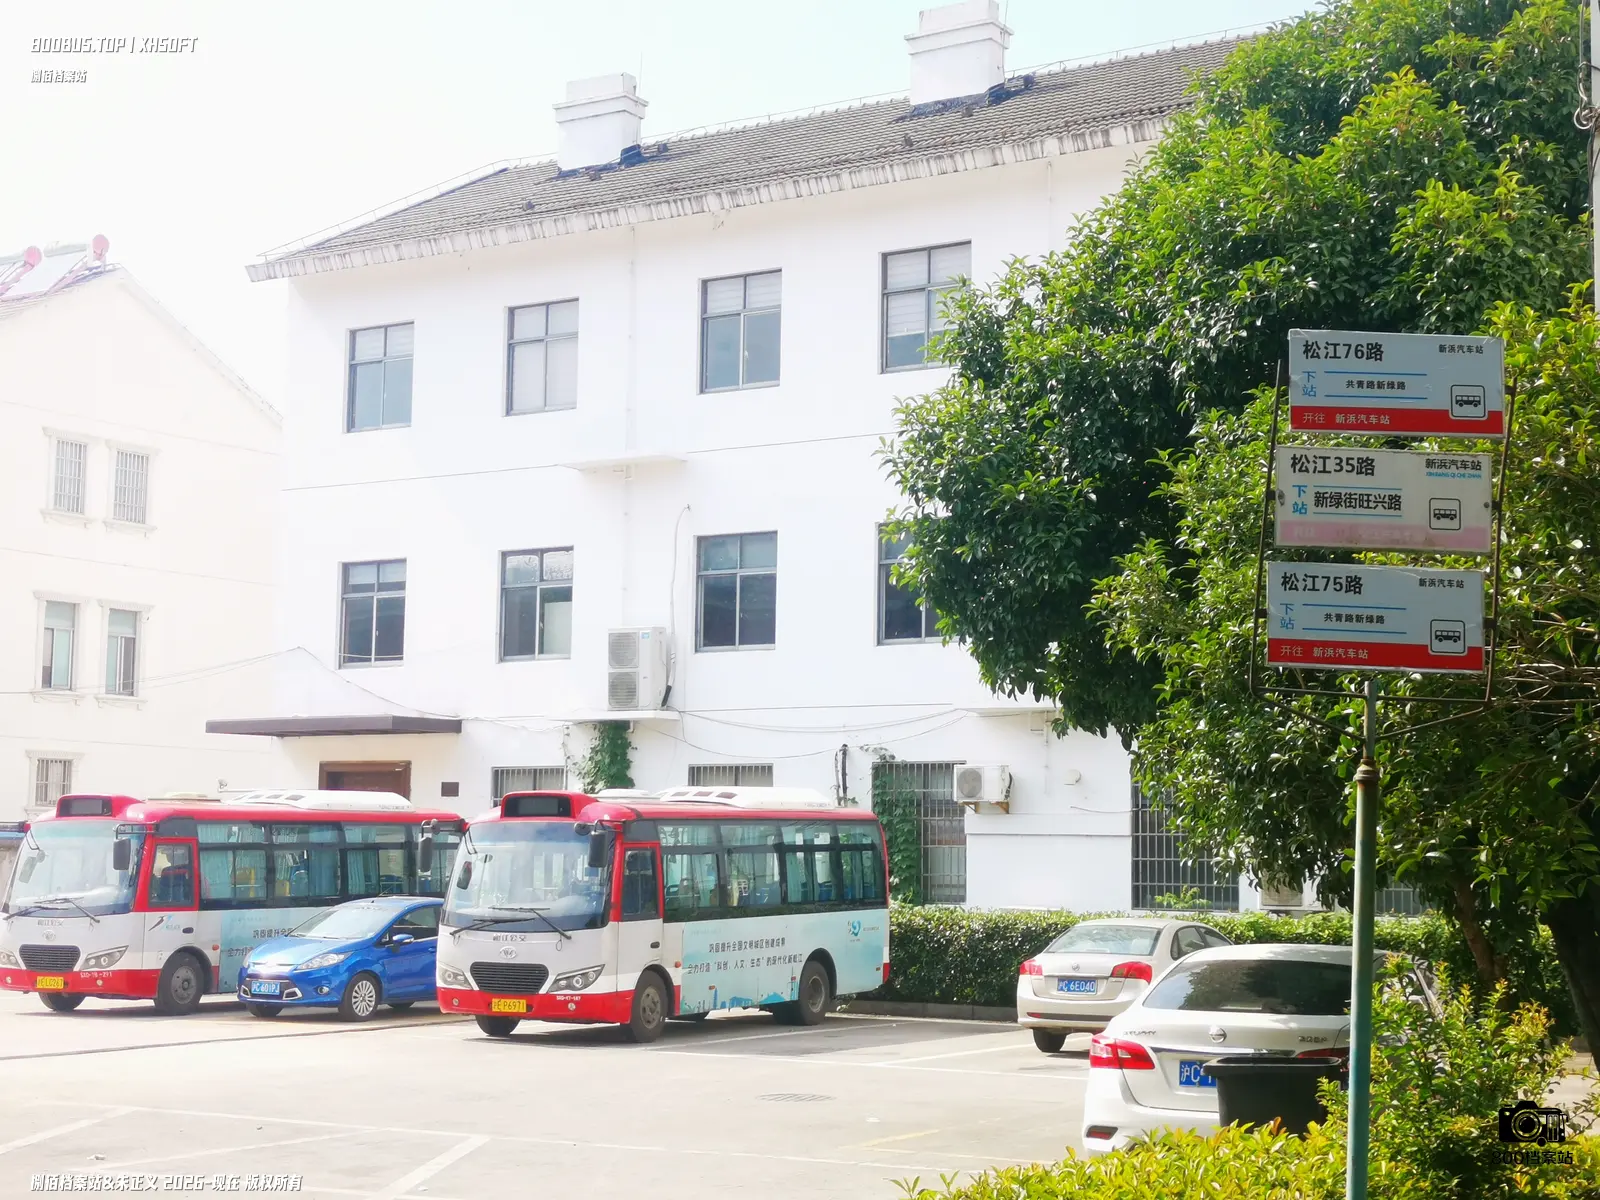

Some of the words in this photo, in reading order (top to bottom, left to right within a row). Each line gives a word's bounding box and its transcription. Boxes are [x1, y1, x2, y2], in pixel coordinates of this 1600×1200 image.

[1302, 340, 1384, 362] 松江76路
[1438, 344, 1484, 354] 新浜汽车站
[1346, 380, 1406, 390] 共青路新绿路
[1303, 412, 1325, 424] 开往
[1335, 413, 1390, 425] 新浜汽车站
[1290, 454, 1375, 477] 松江35路
[1425, 458, 1482, 471] 新浜汽车站
[1314, 491, 1402, 512] 新绿街旺兴路
[1281, 572, 1363, 595] 松江75路
[1419, 578, 1465, 588] 新浜汽车站
[1324, 613, 1385, 624] 共青路新绿路
[1280, 645, 1303, 657] 开往
[1313, 647, 1369, 659] 新浜汽车站
